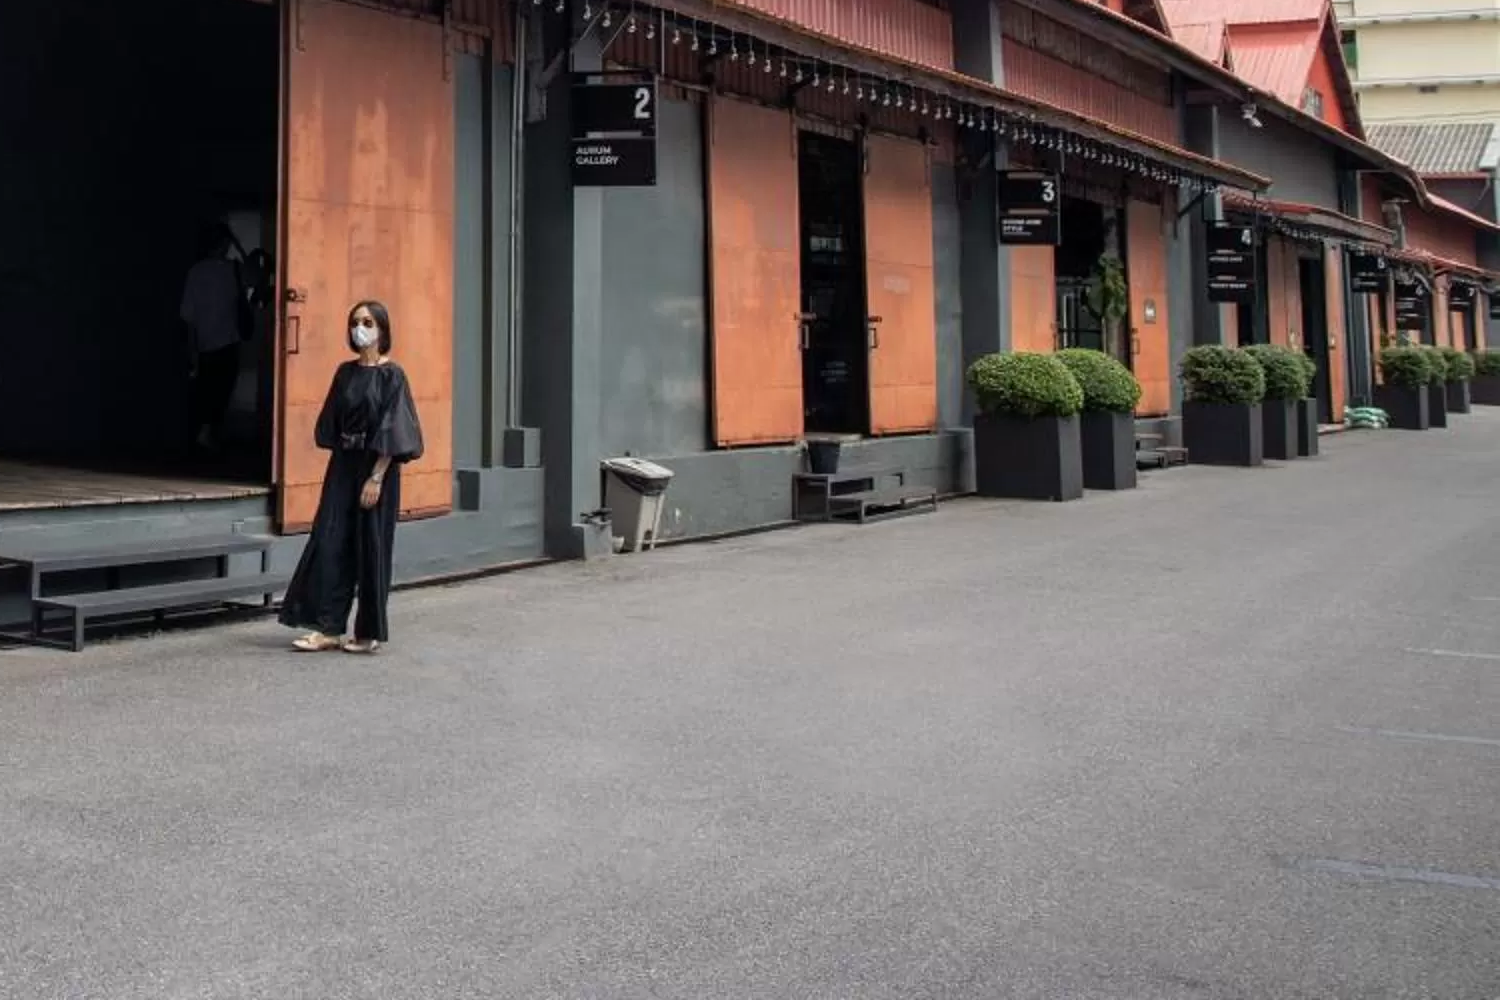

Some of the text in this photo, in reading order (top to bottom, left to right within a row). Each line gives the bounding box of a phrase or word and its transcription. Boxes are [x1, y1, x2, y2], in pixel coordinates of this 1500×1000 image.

[634, 87, 651, 119] 2
[576, 146, 611, 155] AURUM
[576, 156, 618, 165] GALLERY
[1042, 181, 1055, 202] 3
[1241, 229, 1251, 245] 4
